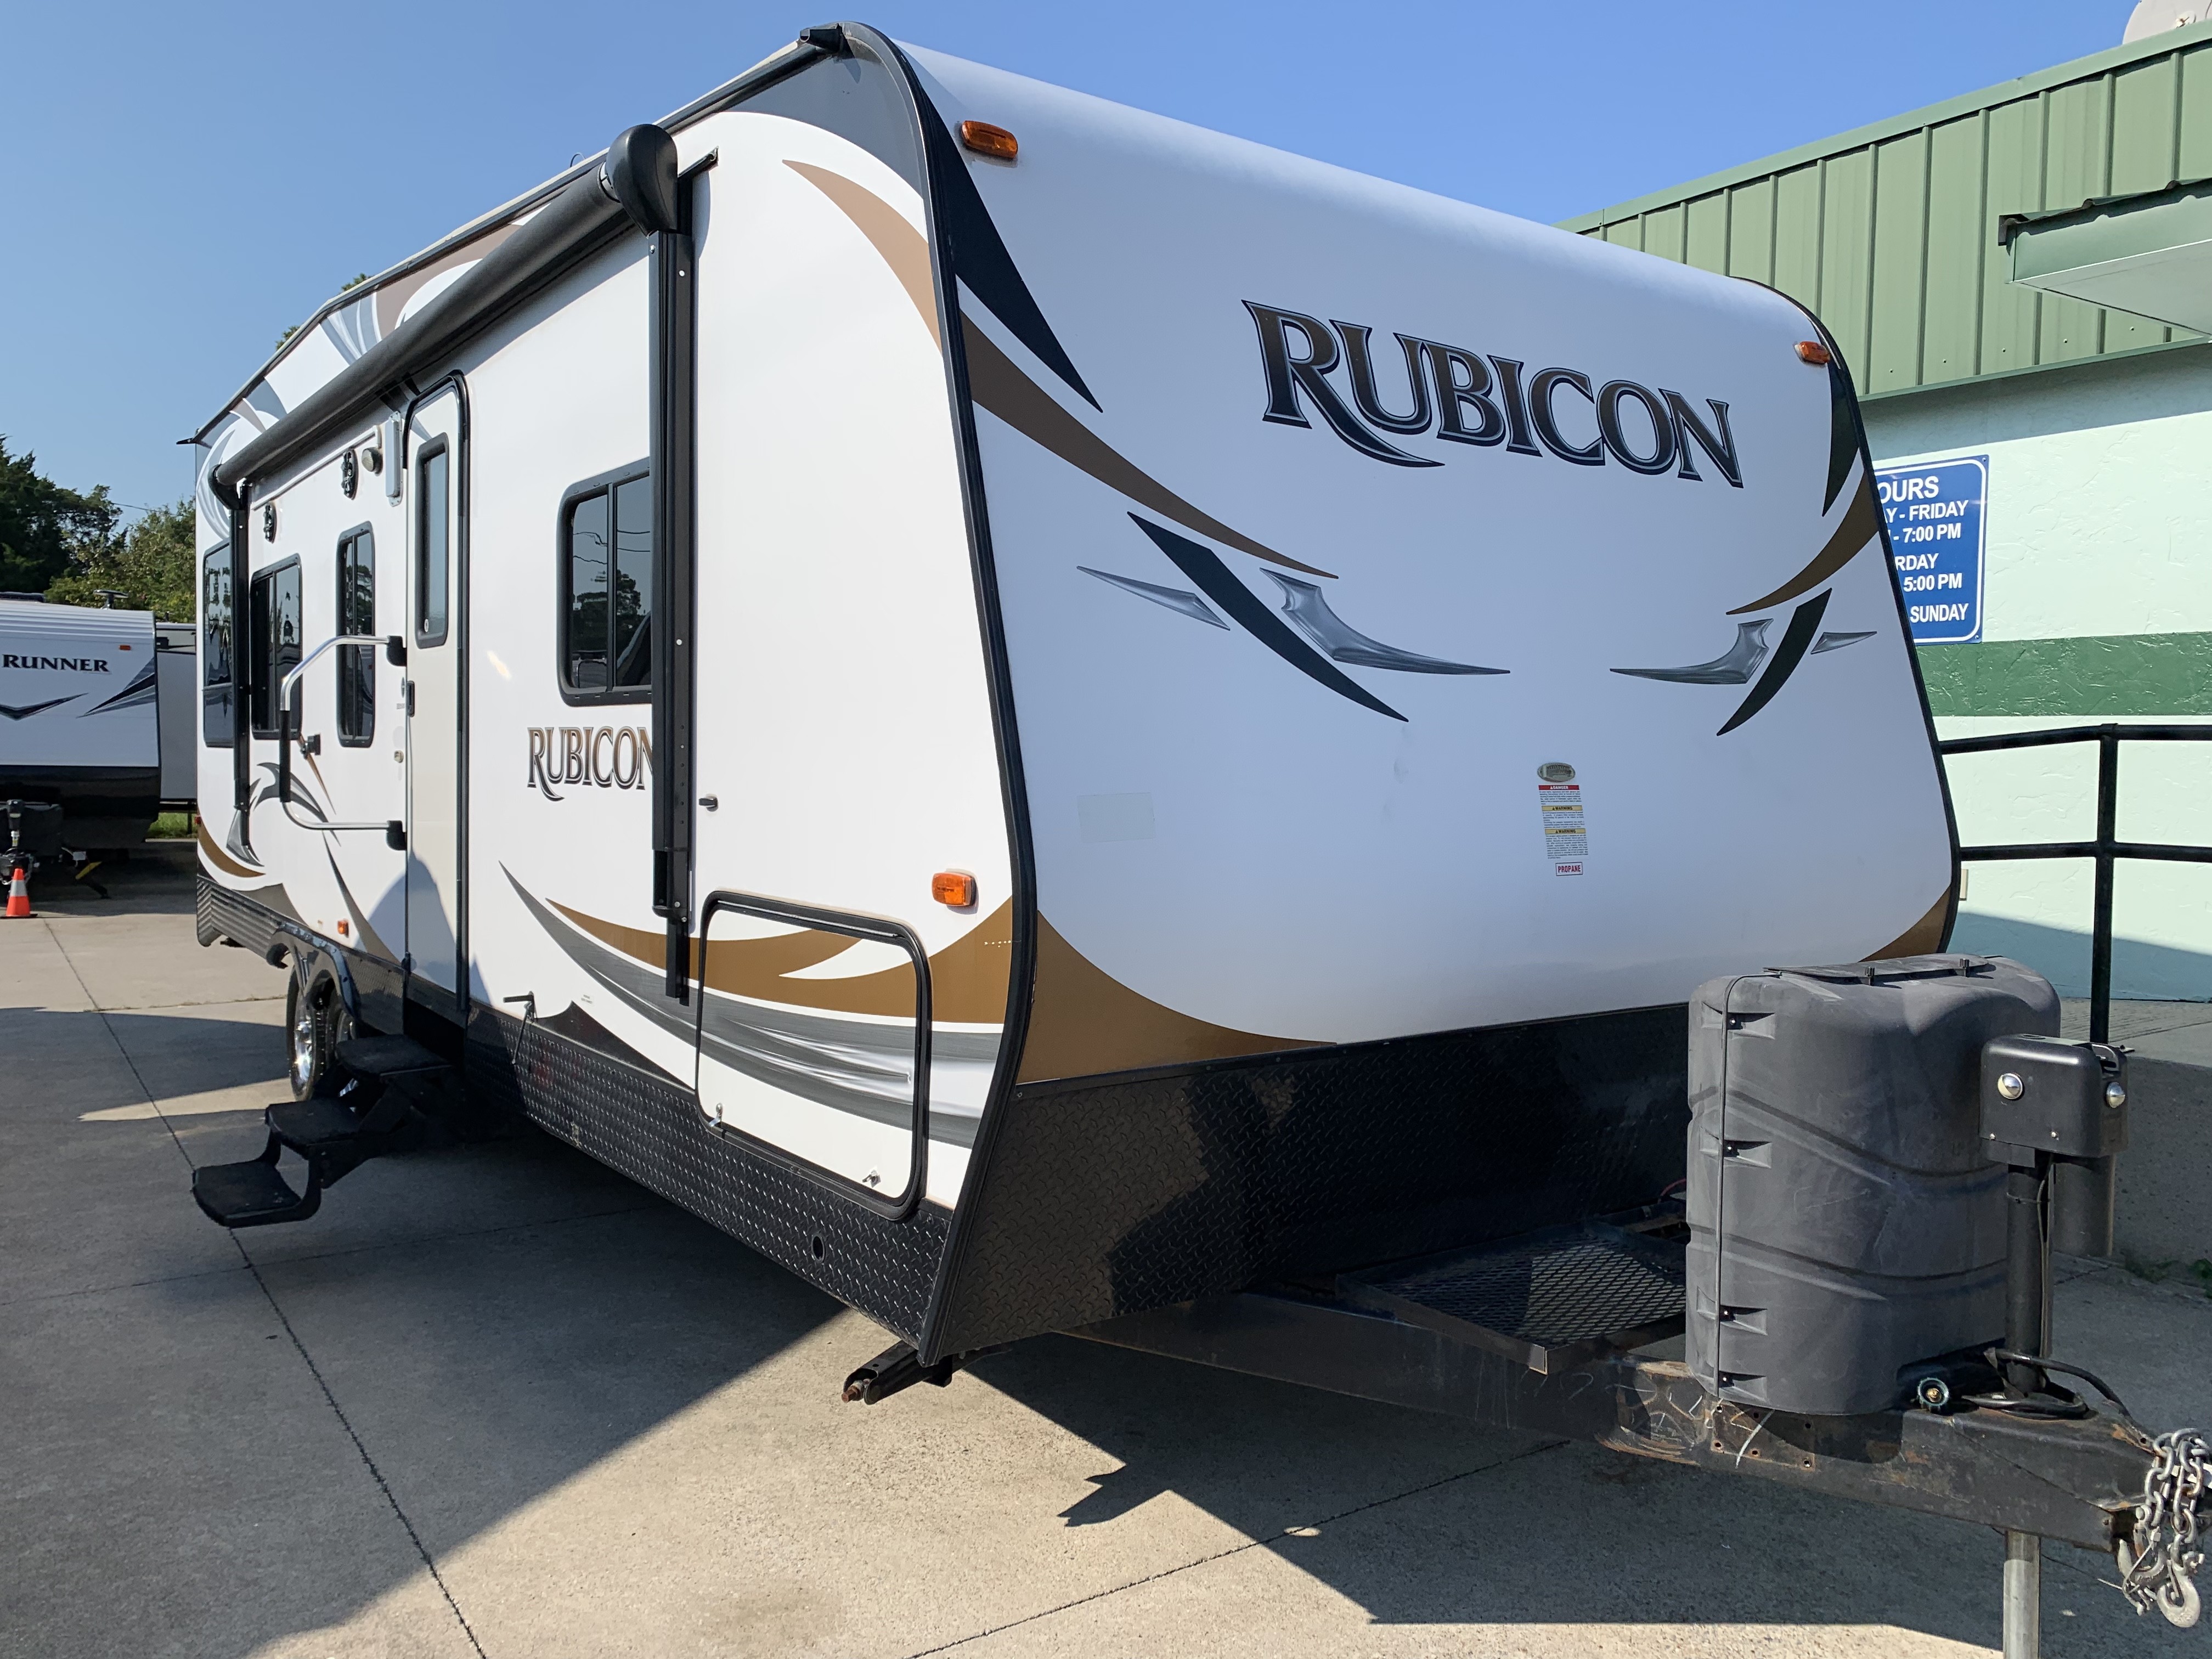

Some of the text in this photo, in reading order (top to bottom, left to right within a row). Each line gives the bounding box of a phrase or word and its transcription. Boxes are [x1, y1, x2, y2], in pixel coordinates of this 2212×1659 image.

[1241, 300, 1743, 488] RUBICON
[1877, 476, 1939, 504] OURS
[1909, 500, 1969, 521] FRIDAY
[1903, 525, 1934, 543] 7:00
[1937, 522, 1961, 540] PM
[1895, 552, 1939, 571] RDAY
[1903, 572, 1962, 592] 5:00 PM
[1910, 603, 1969, 623] SUNDAY
[2, 654, 110, 673] RUNNER
[527, 726, 652, 802] RUBICON
[1558, 865, 1581, 873] PROPANE
